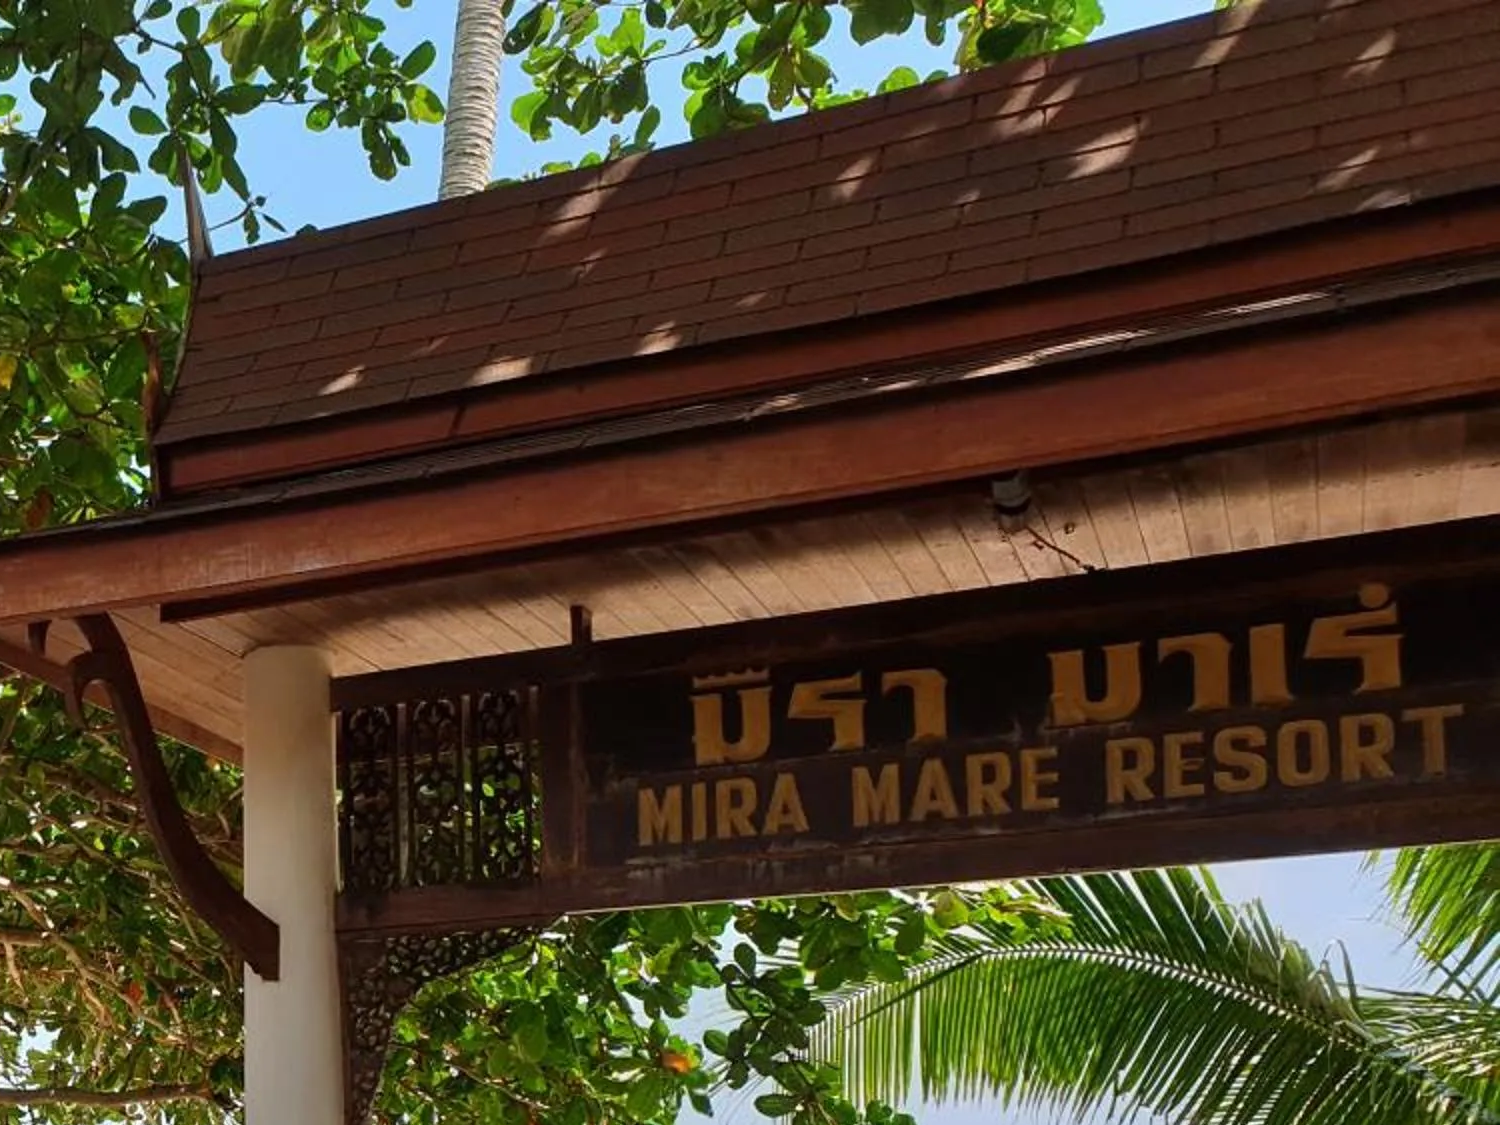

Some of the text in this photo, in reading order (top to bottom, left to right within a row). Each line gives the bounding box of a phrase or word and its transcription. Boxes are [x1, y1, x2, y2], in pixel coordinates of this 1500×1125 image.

[638, 704, 1464, 846] MIRA MARE RESORT
